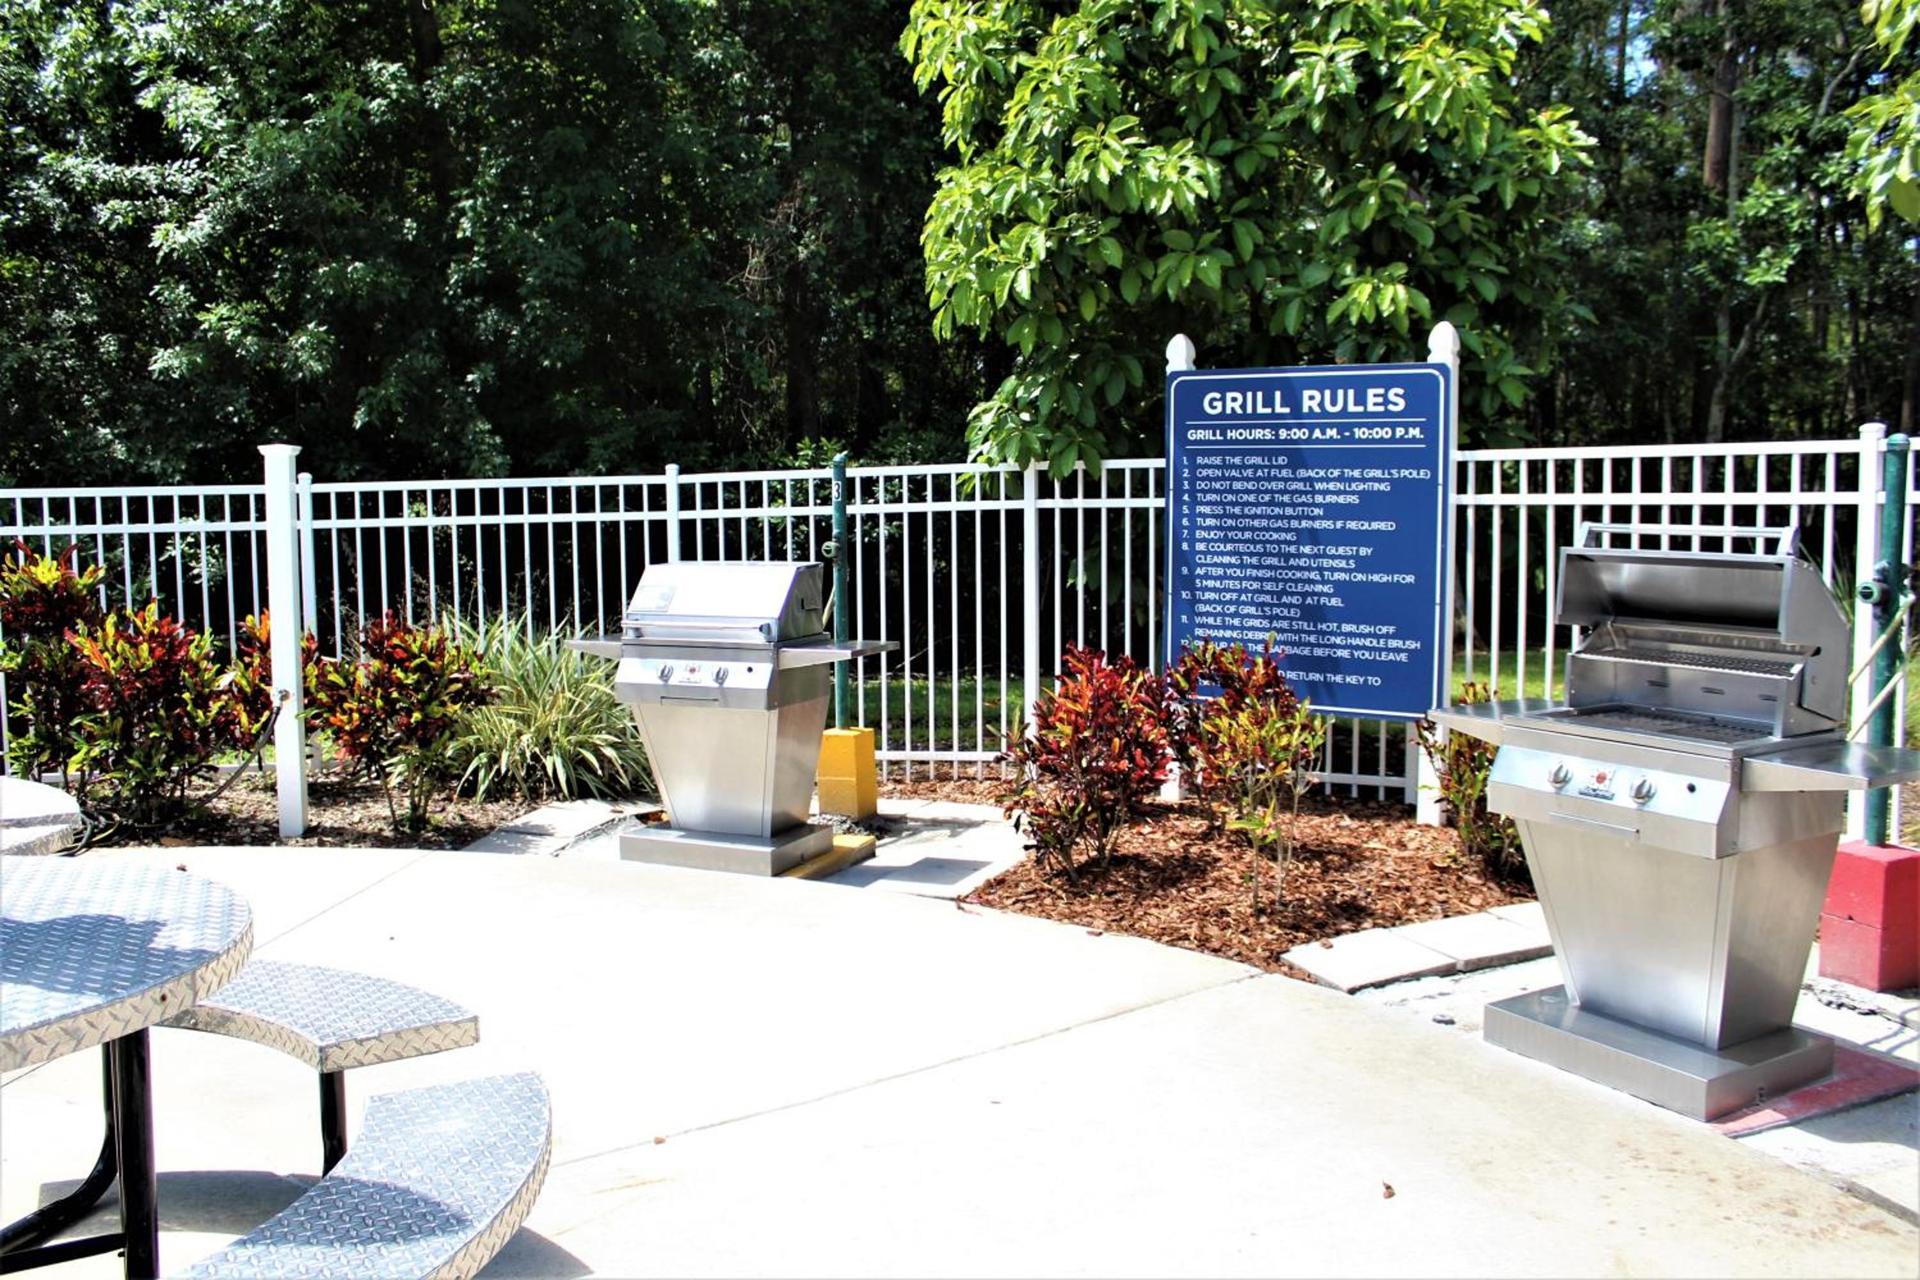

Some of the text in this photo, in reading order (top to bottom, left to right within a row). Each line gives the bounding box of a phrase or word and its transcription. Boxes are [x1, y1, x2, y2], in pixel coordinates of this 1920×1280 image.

[1203, 388, 1406, 415] GRILL RULES
[1187, 429, 1223, 440] GRILL
[1227, 428, 1275, 440] HOURS:
[1278, 428, 1309, 440] 9:00
[1312, 428, 1341, 440] A.M.
[1353, 427, 1392, 439] 10:00
[1395, 427, 1424, 439] P.M.
[1183, 456, 1288, 465] 1. RAISE THE GRILL LID
[1182, 468, 1431, 480] 2. OPEN VALVE AT FUEL (BACK OF THE GRILL'S POLE)
[834, 482, 841, 500] 3
[1182, 480, 1391, 492] 3. DO NOT BEND OVER GRILL WHEN LIGHTING
[1182, 493, 1360, 504] 4. TURN ON ONE OF THE GAS BURNERS
[1182, 505, 1324, 516] 5. PRESS THE IGNITION BUTTON
[1182, 517, 1396, 531] 6. TURN ON OTHER GAS BURNERS IF REQUIRED
[1182, 529, 1298, 541] 7. ENJOY YOUR COOKING
[1181, 542, 1373, 556] 8. BE COURTEOUS TO THE NEXT GUEST BY
[1195, 554, 1356, 569] CLEANING THE GRILL AND UTENSILS
[1181, 566, 1416, 584] 9. AFTER YOU FINISH COOKING, TURN ON HIGH FOR
[1195, 579, 1334, 593] 5 MINUTES FOR SELF CLEANING
[1180, 591, 1345, 607] 10. TURN OFF AT GRILL AND AT FUEL
[1194, 603, 1301, 618] (BACK OF GRILL'S POLE)
[1194, 616, 1224, 626] WHILE
[1225, 617, 1243, 627] THE
[1243, 618, 1271, 628] GRIDS
[1271, 620, 1291, 629] ARE
[1292, 621, 1317, 631] STILL
[1341, 624, 1375, 634] BRUSH
[1375, 626, 1397, 635] OFF
[1194, 628, 1421, 650] REMAINING DEBRI WITH THE LONG HANDLE BRUSH
[1248, 643, 1266, 652] THE
[1313, 647, 1351, 659] BEFORE
[1351, 650, 1375, 660] YOU
[1375, 652, 1409, 662] LEAVE
[1286, 670, 1324, 682] RETURN
[1325, 674, 1345, 684] THE
[1345, 675, 1366, 685] KEY
[1366, 676, 1382, 686] TO
